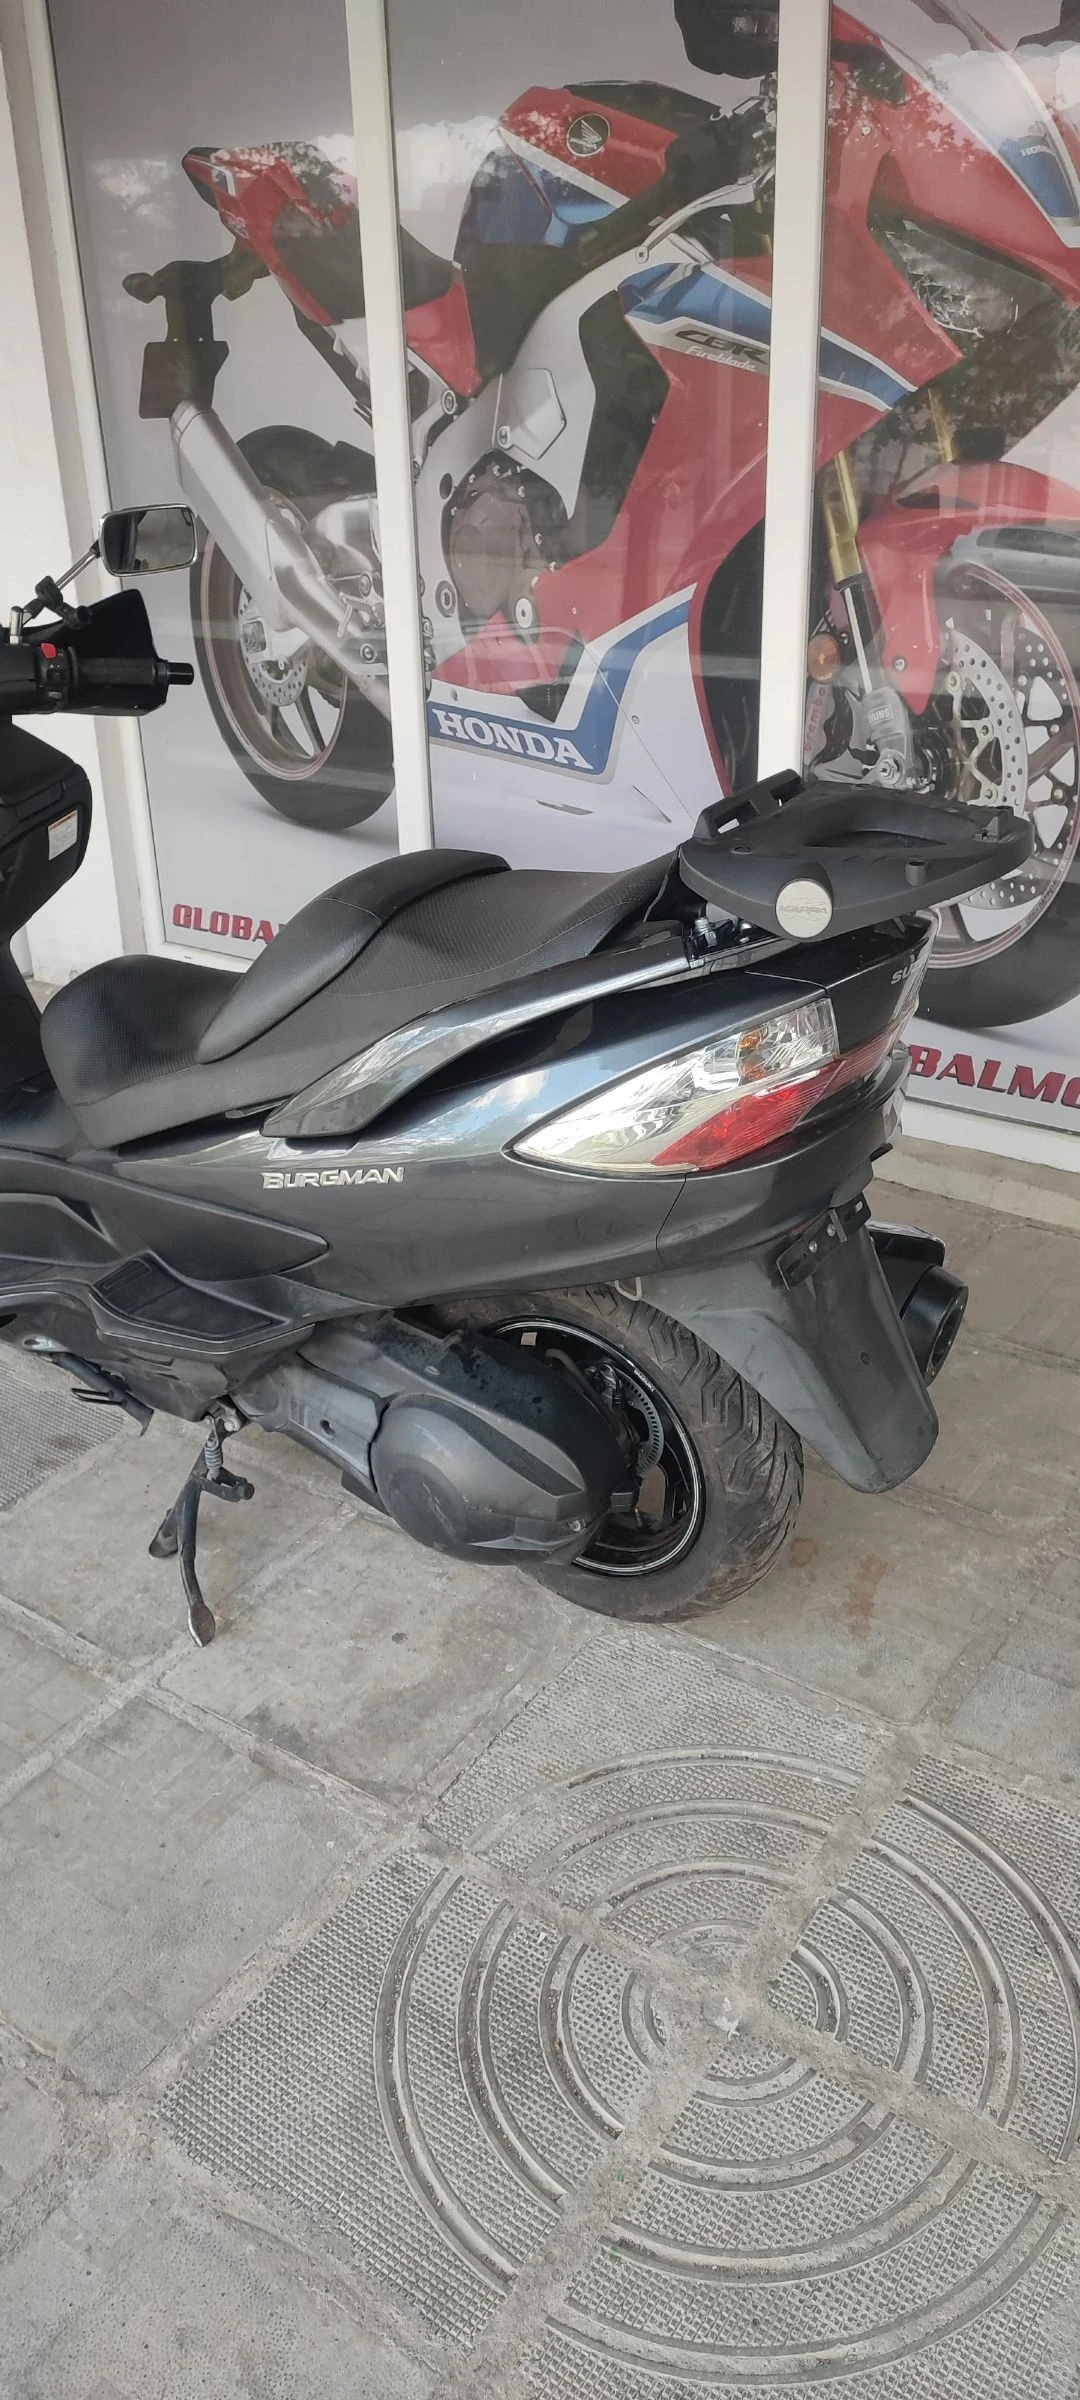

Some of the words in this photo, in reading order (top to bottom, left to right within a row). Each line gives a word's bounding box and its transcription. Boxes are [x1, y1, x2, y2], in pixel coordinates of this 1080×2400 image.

[675, 329, 769, 365] CBR
[685, 346, 757, 373] Fireblade
[431, 708, 594, 770] HONDA
[172, 903, 287, 944] GLOBA
[261, 1166, 405, 1190] BURGMAN
